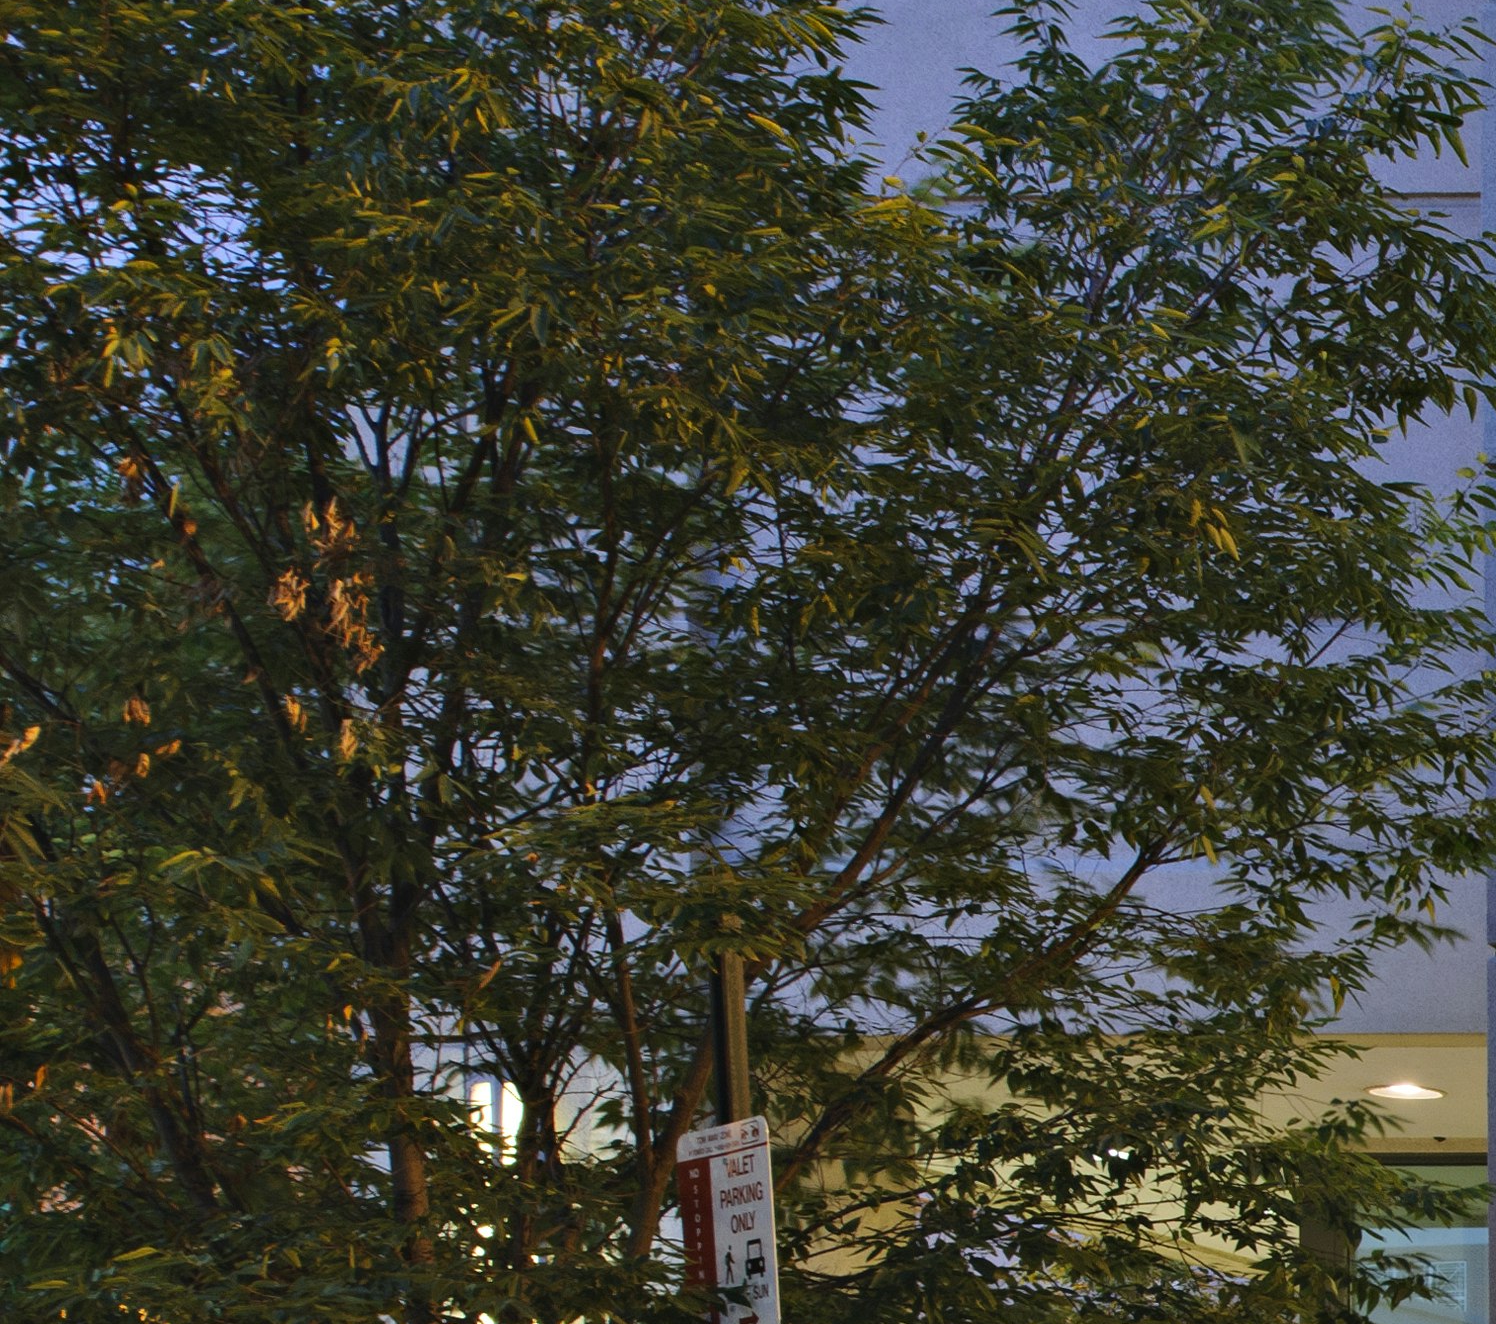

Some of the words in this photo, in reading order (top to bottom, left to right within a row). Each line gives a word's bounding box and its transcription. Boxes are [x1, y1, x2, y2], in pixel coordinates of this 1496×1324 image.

[723, 1154, 755, 1179] VALET
[720, 1181, 764, 1209] PARKING
[731, 1211, 756, 1234] ONLY
